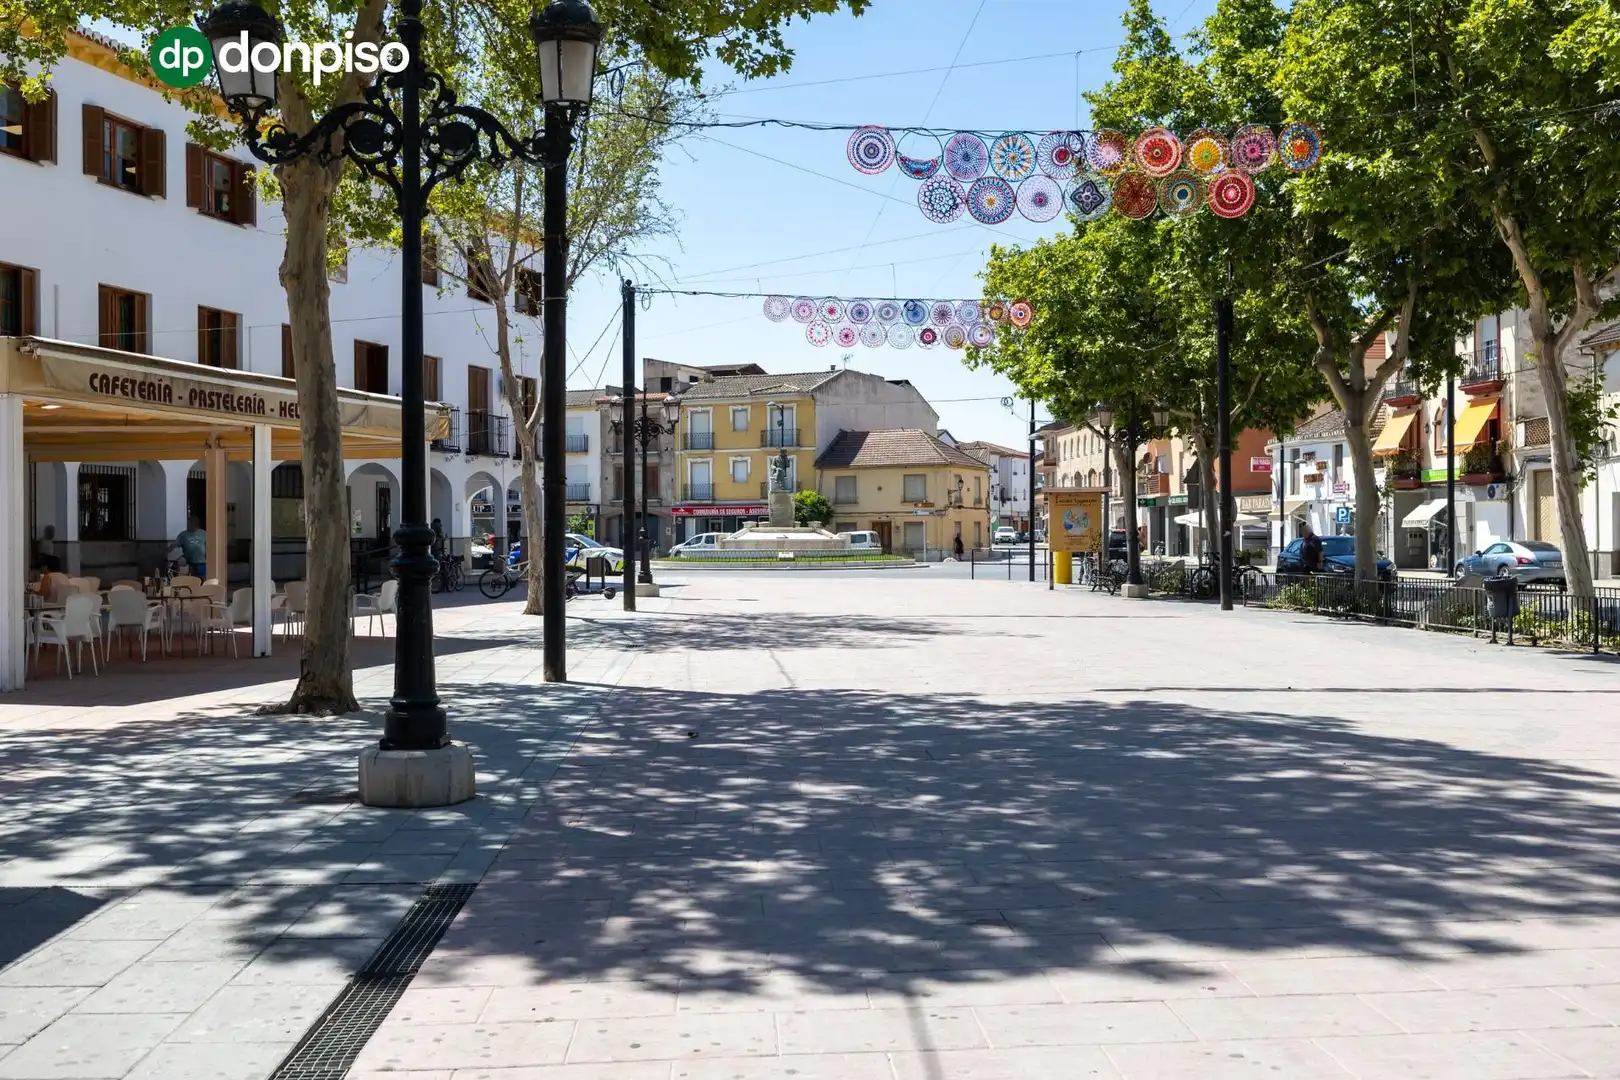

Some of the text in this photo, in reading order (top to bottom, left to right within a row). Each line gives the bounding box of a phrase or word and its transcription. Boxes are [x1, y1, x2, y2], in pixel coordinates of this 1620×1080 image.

[89, 373, 172, 403] CAFETERÍA
[188, 388, 266, 415] PASTELERÍA
[279, 401, 301, 420] HEL
[1338, 508, 1347, 521] P
